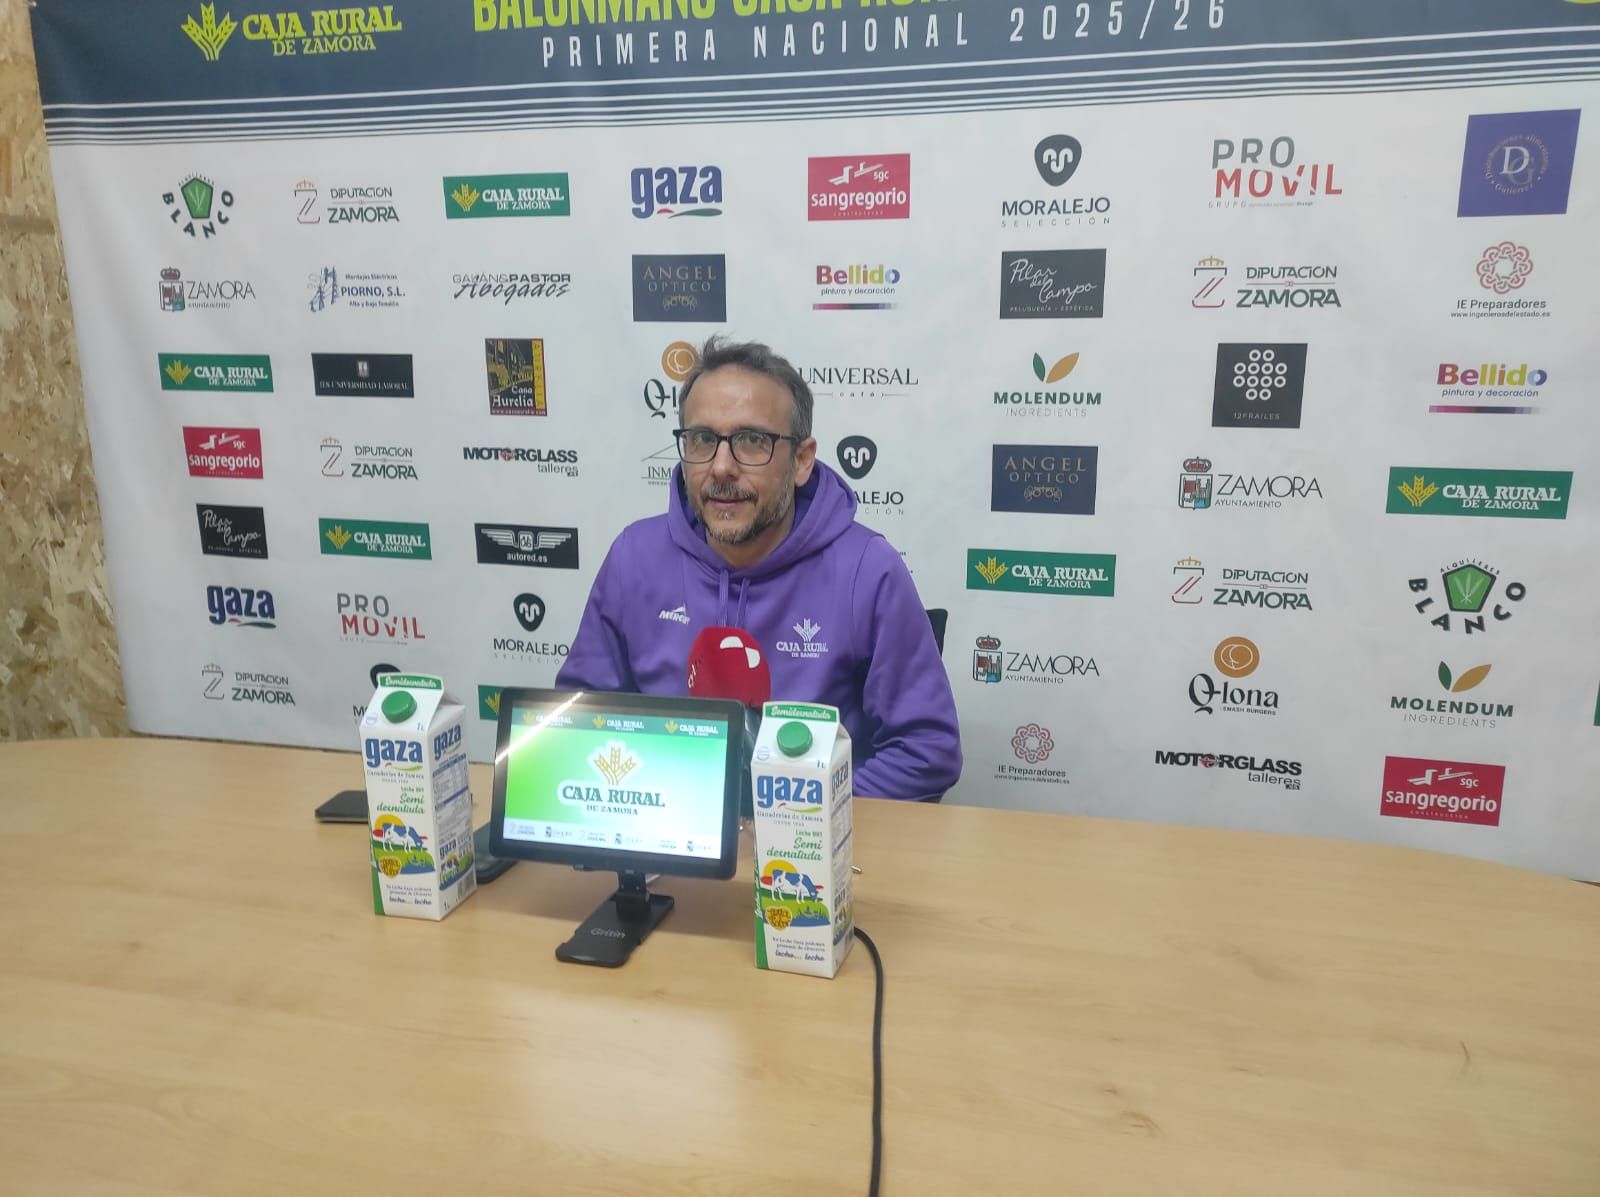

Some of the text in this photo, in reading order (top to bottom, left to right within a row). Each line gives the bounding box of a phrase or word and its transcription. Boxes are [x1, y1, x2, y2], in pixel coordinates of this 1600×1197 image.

[242, 5, 402, 40] CAJA RURAL
[543, 0, 1224, 68] PRIMERA NACIONAL 2025/26
[272, 35, 376, 56] DE ZAMORA
[1212, 136, 1295, 169] PRO
[873, 170, 889, 182] sgc
[482, 187, 565, 203] CAJA RURAL
[631, 165, 723, 219] gaza
[811, 187, 907, 211] sangregorio
[496, 200, 551, 210] DE ZAMORA
[1002, 197, 1111, 216] MORALEJO
[162, 190, 235, 239] BLANCO
[327, 205, 400, 224] ZAMORA
[643, 265, 717, 280] ANGEL
[816, 264, 900, 285] Bellido
[186, 280, 257, 300] ZAMORA
[341, 286, 406, 301] PIORNO, S.L.
[453, 282, 571, 306] Abogados
[648, 281, 711, 292] OPTICO
[820, 286, 896, 296] pintura y decoración
[1039, 278, 1097, 304] Campo
[1236, 288, 1342, 308] ZAMORA
[1456, 299, 1547, 311] IE Preparadores
[194, 366, 269, 379] CAJA RURAL
[798, 367, 919, 385] UNIVERSAL
[1437, 363, 1547, 386] Bellido
[208, 378, 256, 386] DE ZAMORA
[511, 385, 533, 394] Casa
[492, 395, 534, 407] Aurelia
[993, 391, 1101, 405] MOLENDUM
[1441, 387, 1539, 399] pintura y decoración
[1006, 407, 1087, 417] INGREDIENTS
[233, 440, 246, 450] sgc
[188, 453, 260, 471] sangregorio
[463, 447, 578, 463] MOTORGLASS
[351, 463, 418, 480] ZAMORA
[537, 463, 578, 474] talleres
[1005, 456, 1086, 472] ANGEL
[1009, 471, 1079, 484] OPTICO
[1217, 474, 1323, 499] ZAMORA
[1442, 484, 1561, 501] CAJA RURAL
[854, 491, 904, 505] ALEJO
[1214, 499, 1282, 509] AYUNTAMIENTO
[1462, 499, 1539, 511] DE ZAMORA
[353, 531, 426, 547] CAJA RURAL
[367, 543, 414, 554] DE ZAMORA
[506, 552, 548, 563] autored.es
[1011, 564, 1108, 581] CAJA RURAL
[1028, 578, 1091, 589] DE ZAMORA
[207, 585, 275, 625] gaza
[337, 592, 390, 617] PRO
[1213, 588, 1313, 611] ZAMORA
[1408, 577, 1527, 635] BLANCO
[493, 638, 569, 656] MORALEJO
[776, 641, 800, 653] CAJA
[1006, 652, 1100, 677] ZAMORA
[1005, 674, 1064, 684] AYUNTAMIENTO
[231, 687, 296, 706] ZAMORA
[1246, 707, 1276, 716] BURGERS
[1390, 696, 1514, 717] MOLENDUM
[1403, 714, 1496, 729] INGREDIENTS
[433, 724, 461, 761] gaza
[365, 738, 423, 768] gaza
[998, 765, 1066, 778] IE Preparadores
[1155, 750, 1302, 777] MOTORGLASS
[831, 760, 849, 801] gaza
[1248, 771, 1302, 787] talleres
[1460, 776, 1479, 788] sgc
[400, 793, 424, 805] Semi
[562, 785, 666, 807] CAJA RURAL
[757, 775, 823, 809] gaza
[1385, 789, 1497, 813] sangregorio
[600, 805, 639, 816] ZAMORA
[793, 837, 823, 850] Semi
[766, 846, 823, 861] desnatada
